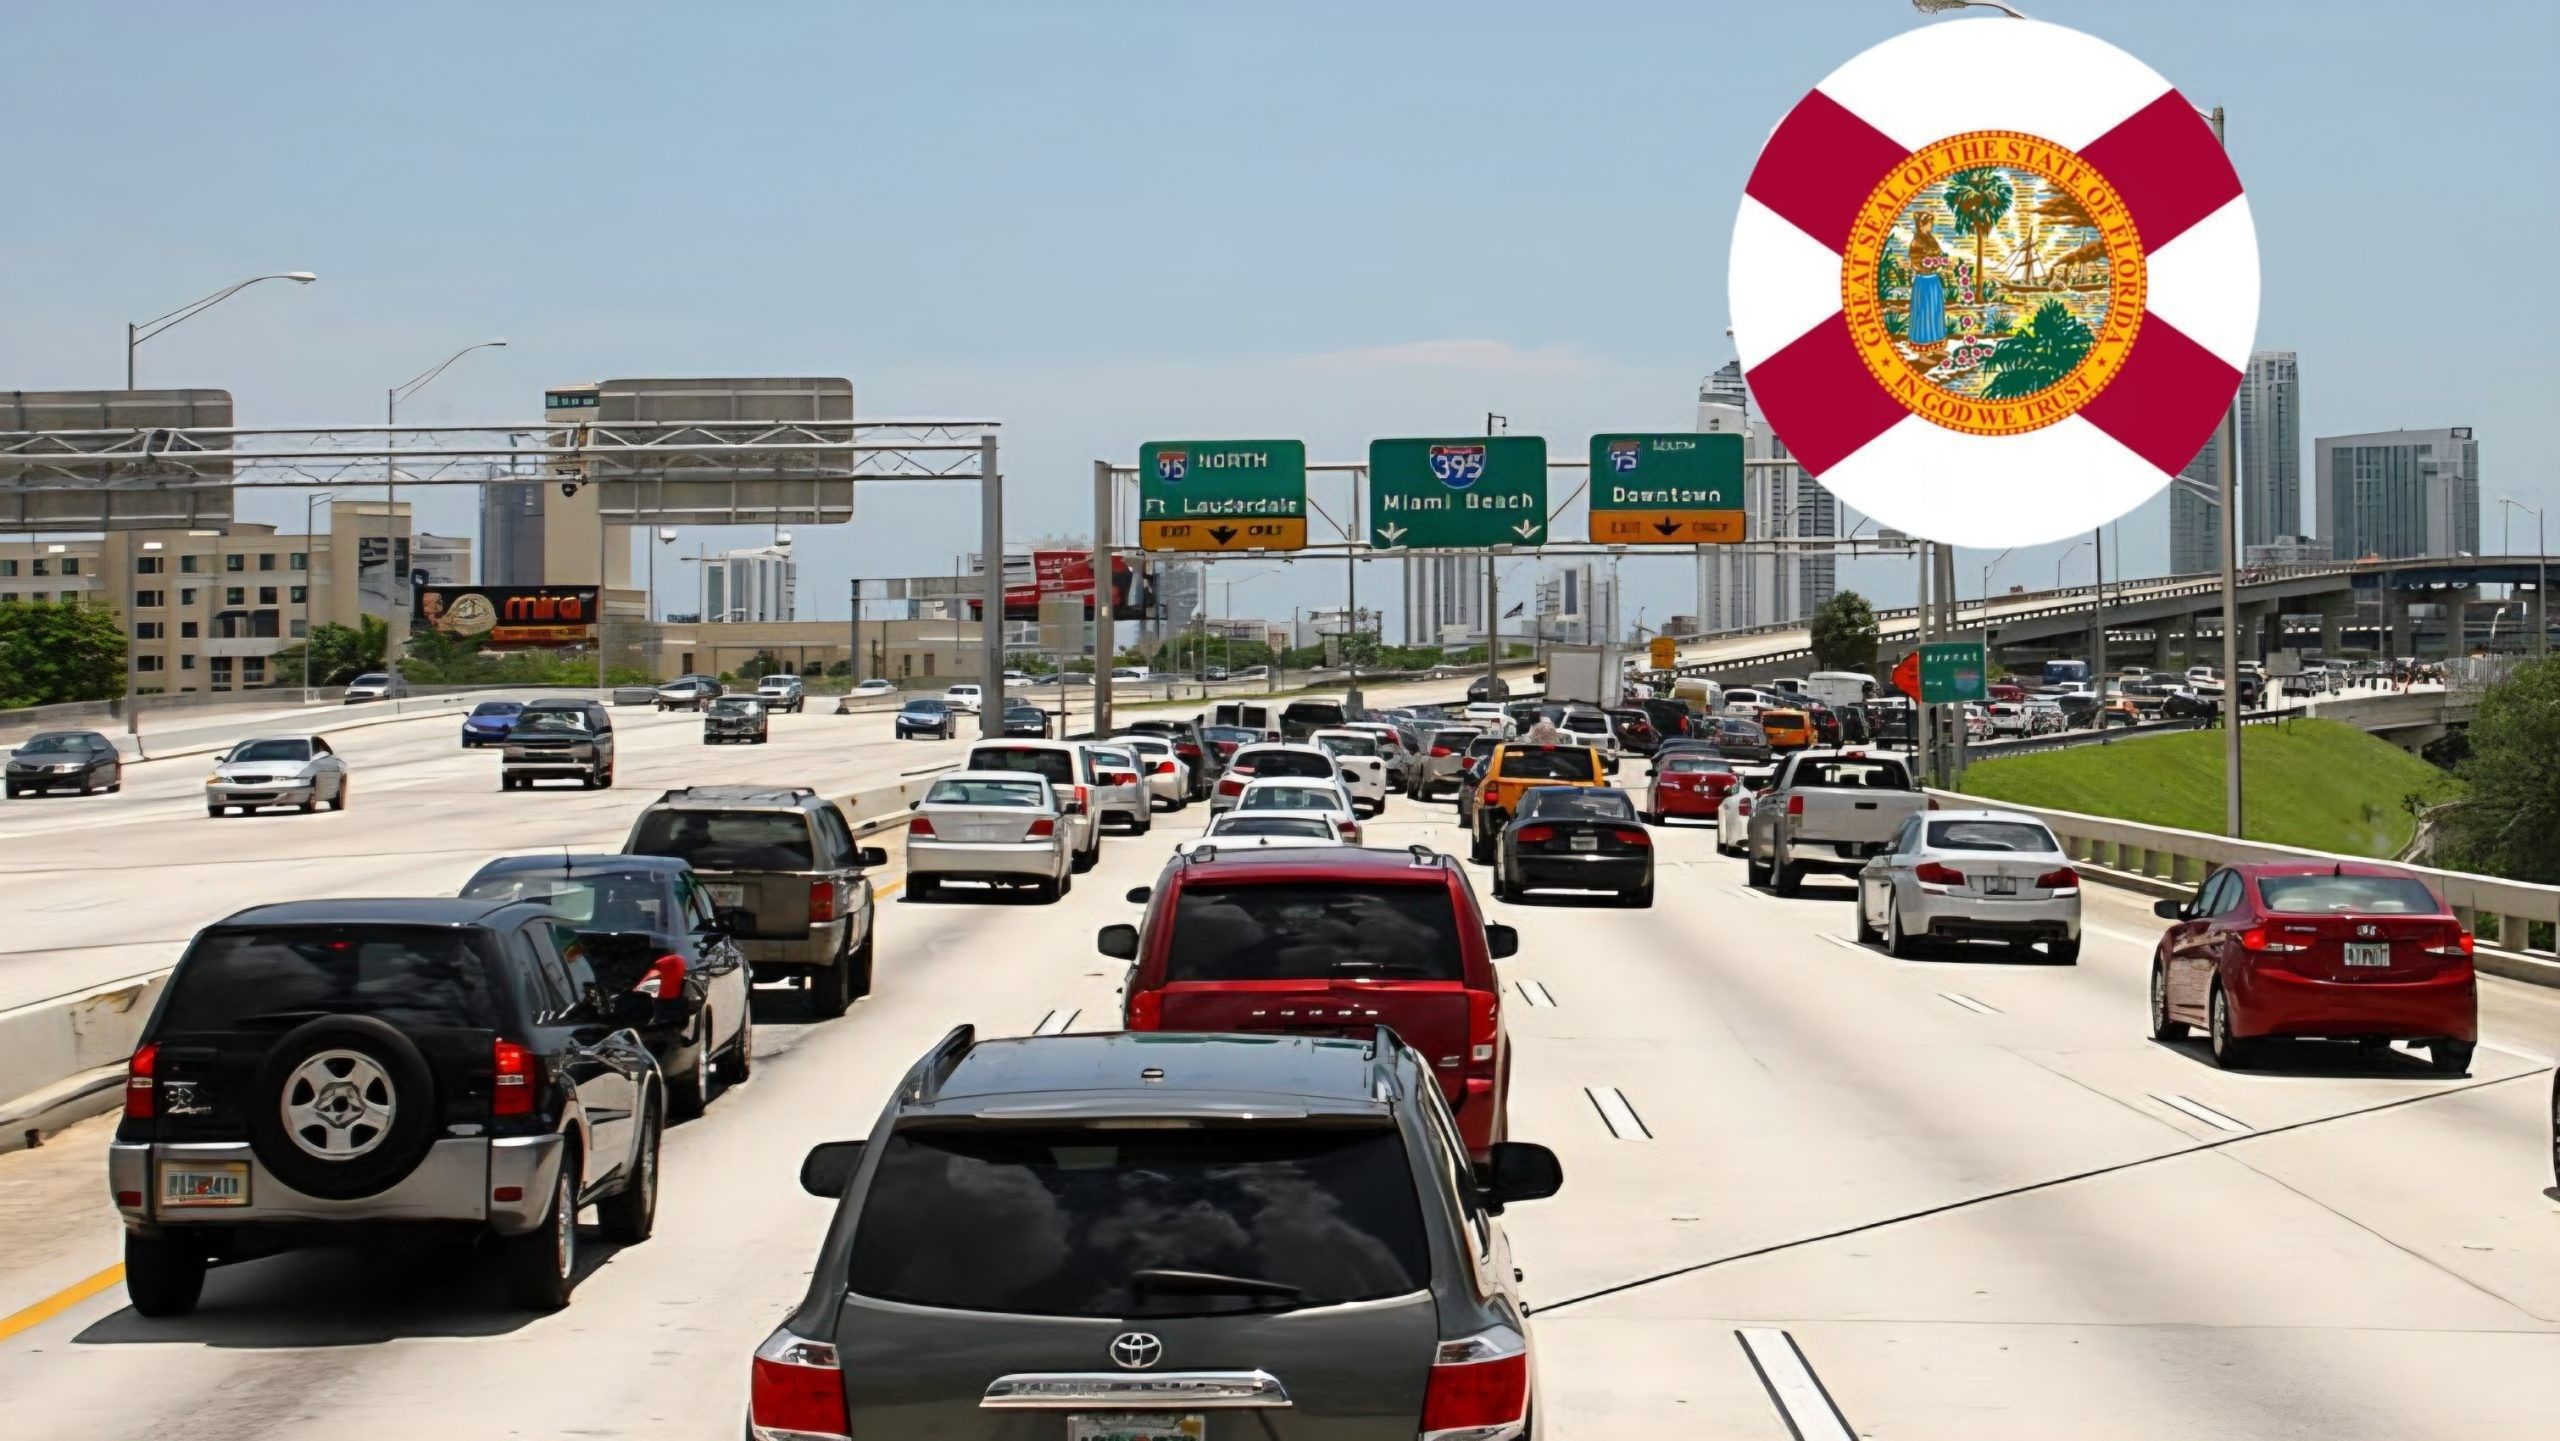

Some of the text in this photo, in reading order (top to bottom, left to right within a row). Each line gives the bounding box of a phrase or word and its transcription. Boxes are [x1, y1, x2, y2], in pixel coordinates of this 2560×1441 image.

[1198, 452, 1268, 469] NORTH
[1434, 454, 1482, 479] 395
[1383, 491, 1534, 511] Miami Beach
[1612, 485, 1721, 502] Downtown
